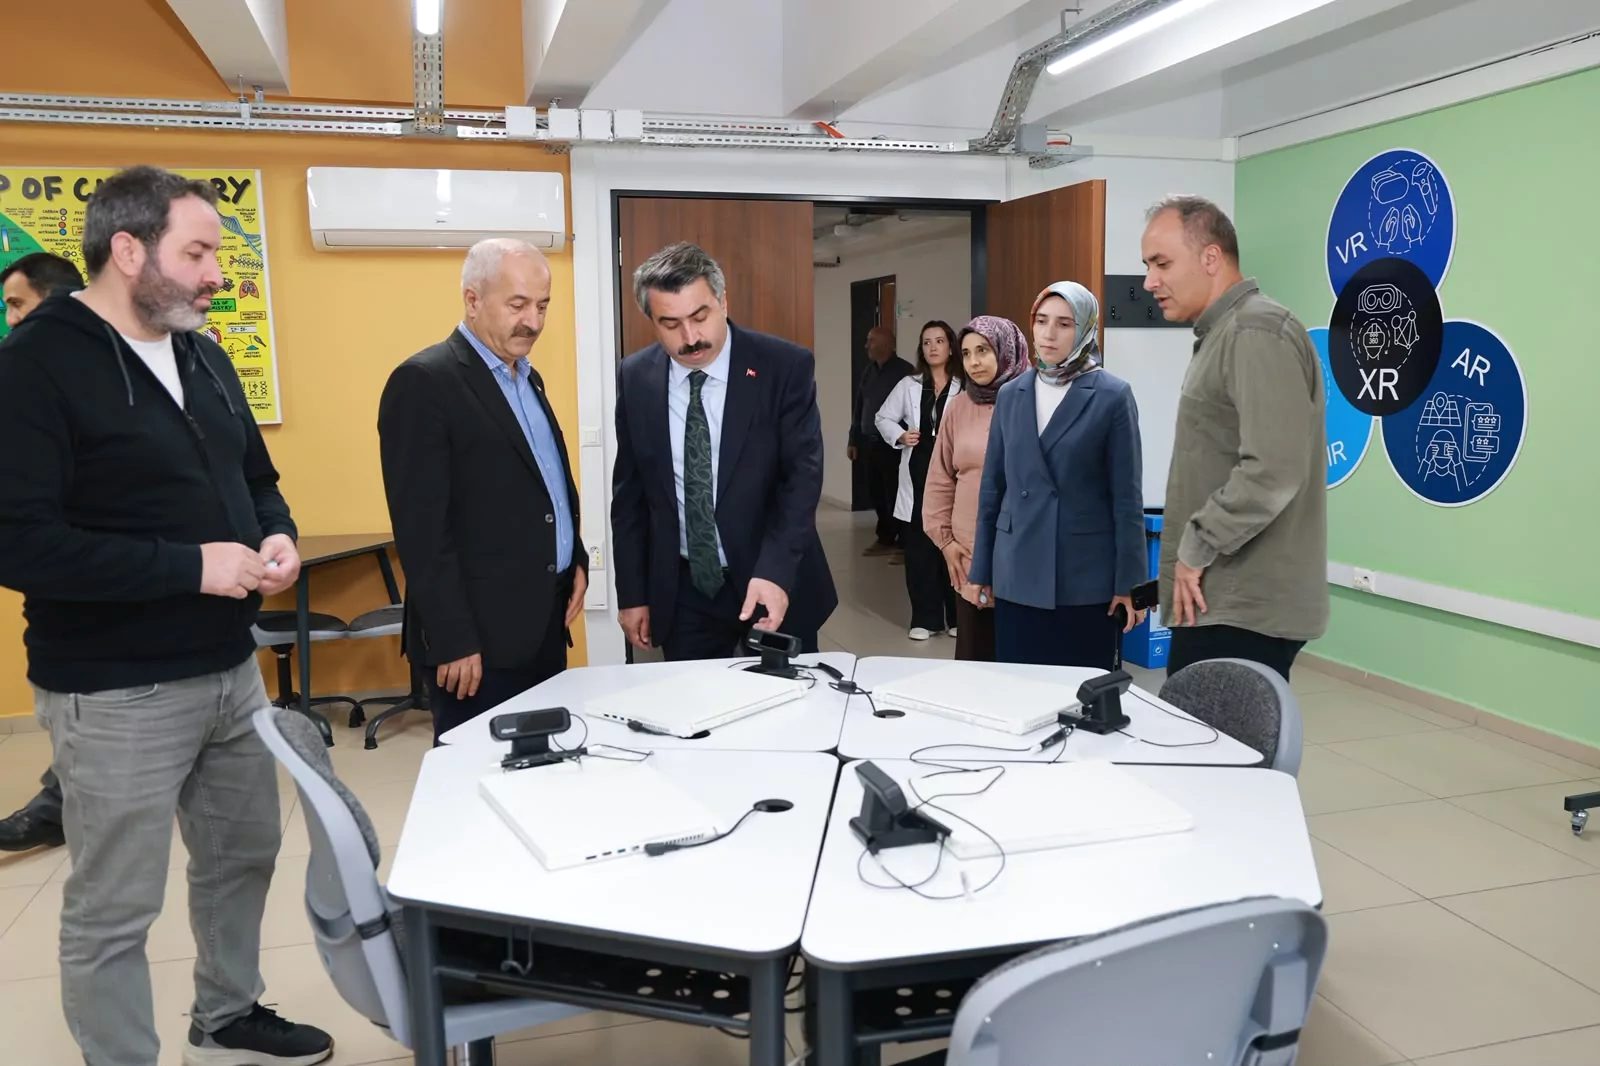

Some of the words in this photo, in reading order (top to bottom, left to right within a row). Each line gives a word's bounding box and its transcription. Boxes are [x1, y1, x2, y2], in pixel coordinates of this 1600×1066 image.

[22, 176, 62, 200] OF
[1335, 231, 1368, 264] VR
[1450, 347, 1491, 387] AR
[1356, 368, 1400, 401] XR
